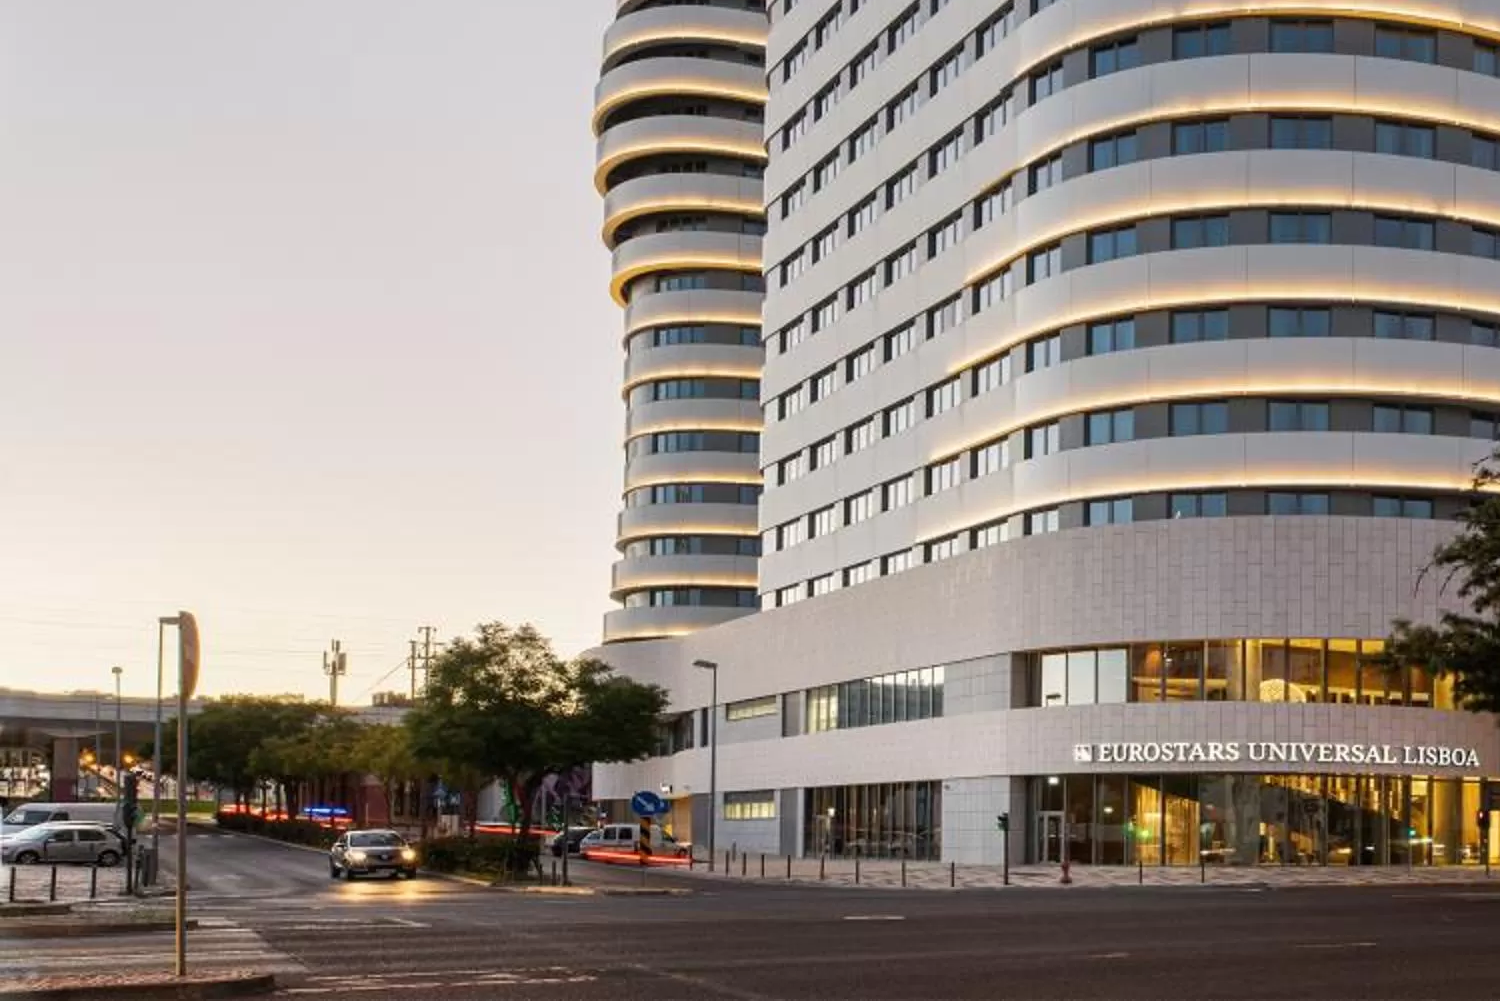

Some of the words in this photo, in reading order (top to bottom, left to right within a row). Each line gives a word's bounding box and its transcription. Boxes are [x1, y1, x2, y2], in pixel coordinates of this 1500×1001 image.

[1099, 742, 1239, 762] EUROSTARS
[1248, 742, 1397, 764] UNIVERSAL
[1402, 746, 1480, 767] LISBOA
